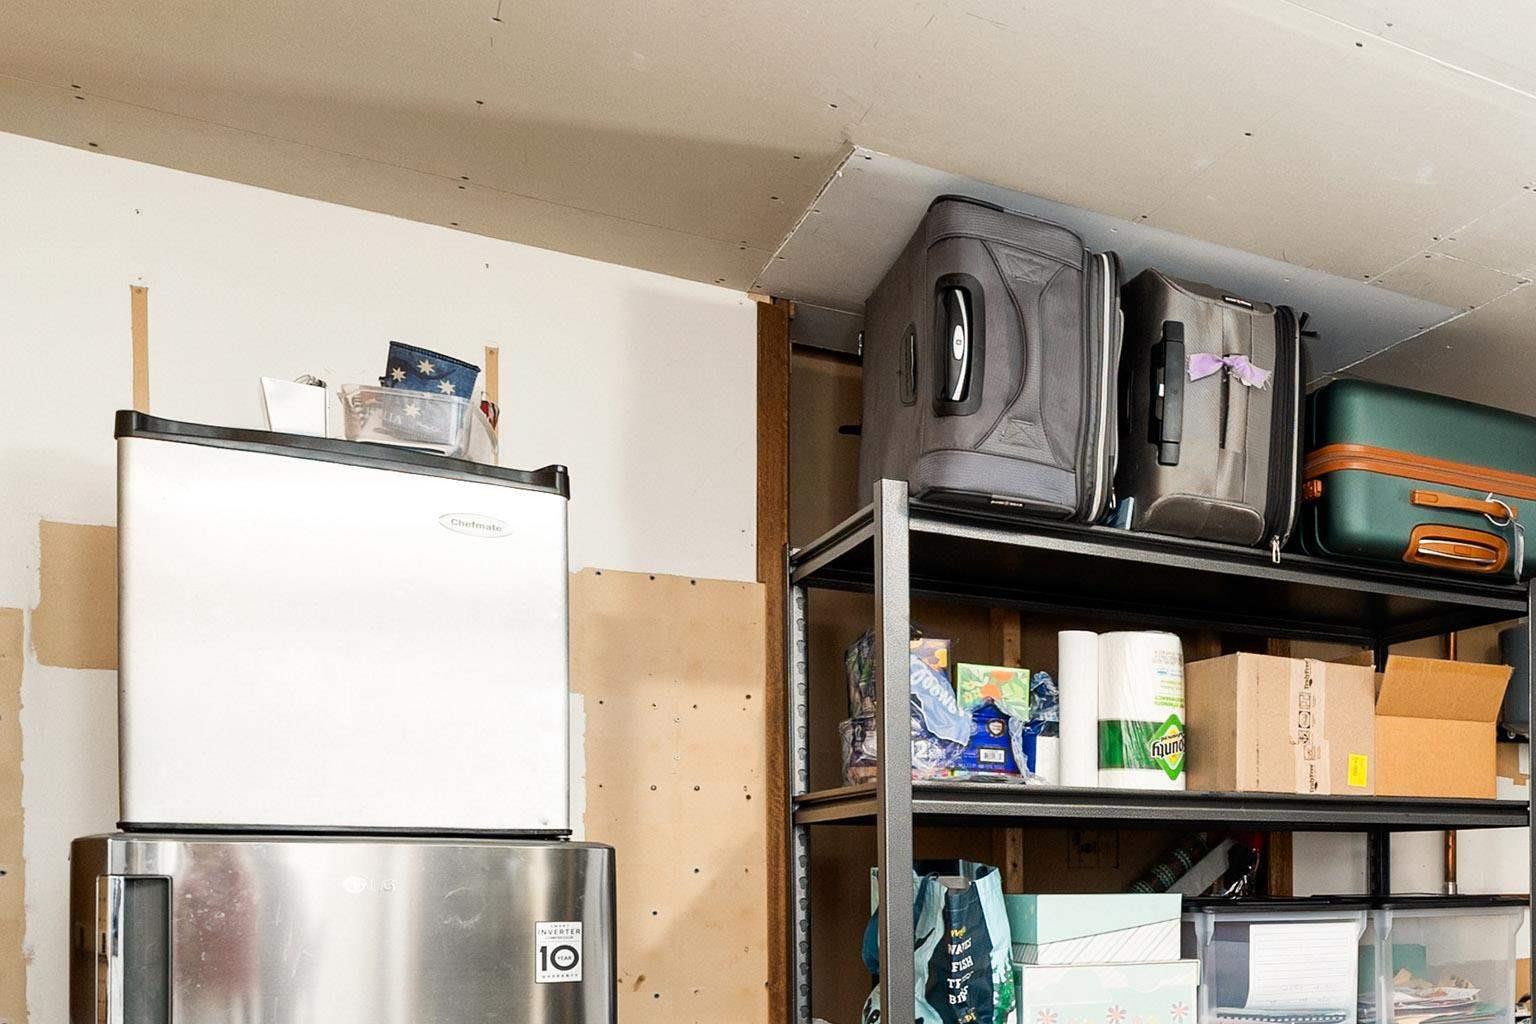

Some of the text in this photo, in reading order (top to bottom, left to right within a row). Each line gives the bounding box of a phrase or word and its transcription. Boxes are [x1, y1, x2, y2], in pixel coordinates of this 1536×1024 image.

[450, 518, 502, 532] Chefmate
[1151, 740, 1186, 758] ounty
[540, 945, 579, 971] 10
[951, 955, 974, 972] FISH
